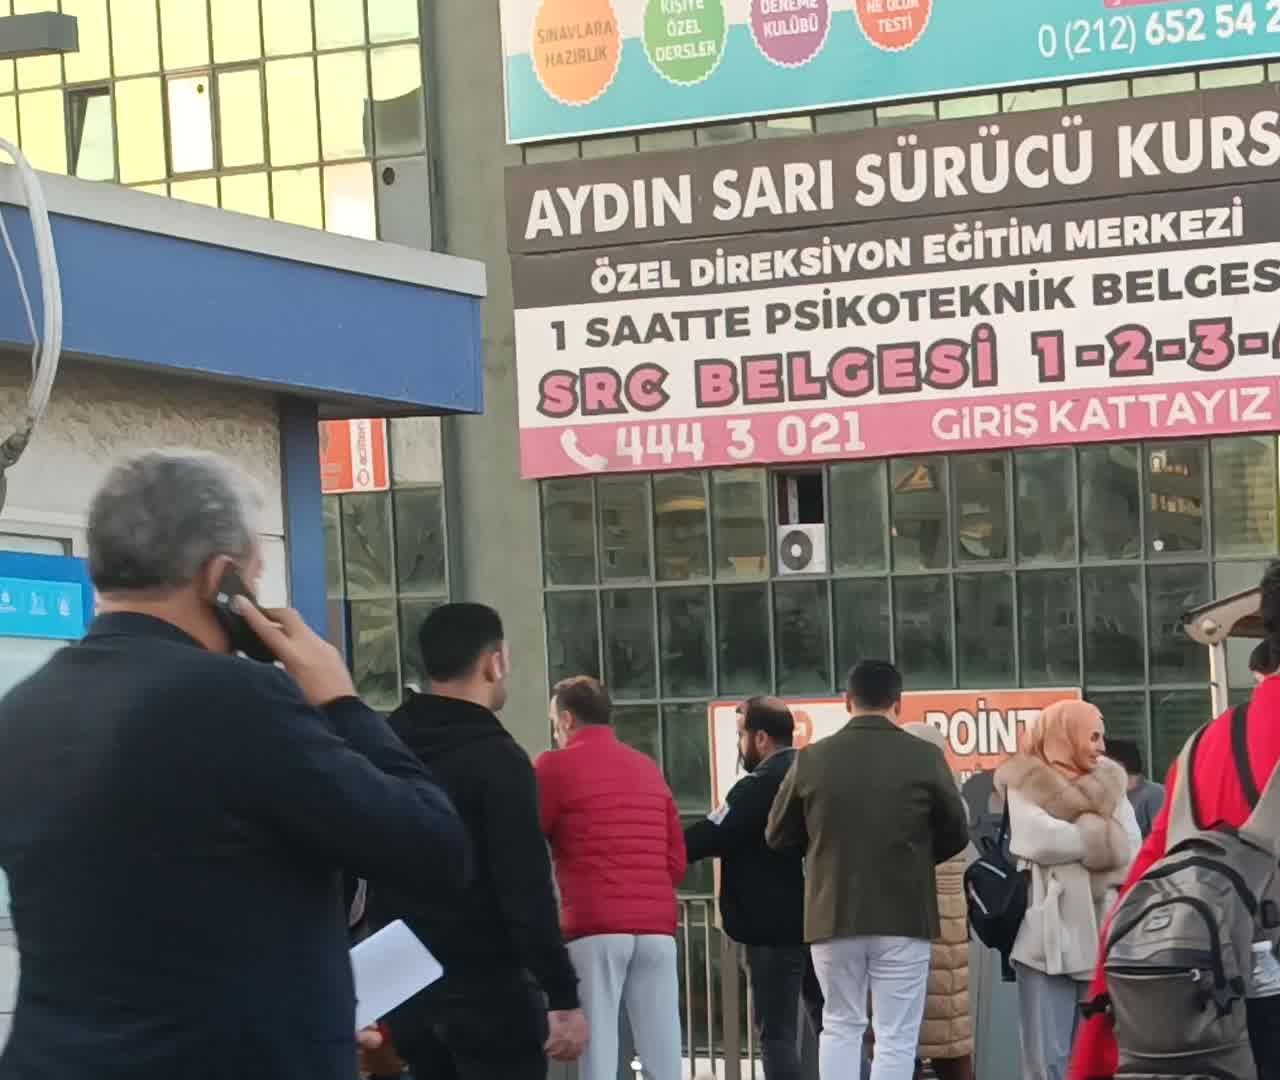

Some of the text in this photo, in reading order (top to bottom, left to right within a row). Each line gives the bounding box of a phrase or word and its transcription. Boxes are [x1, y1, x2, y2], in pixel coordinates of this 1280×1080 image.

[537, 21, 613, 45] SINAVLARA
[666, 17, 702, 38] ÖZEL
[763, 14, 819, 38] KULÜBÜ
[876, 15, 913, 33] TESTİ
[1038, 24, 1057, 58] 0
[1064, 14, 1137, 61] (212)
[1145, 7, 1206, 46] 652
[1215, 3, 1257, 39] 54
[545, 45, 609, 68] HAZIRLIK
[655, 36, 717, 62] DERSLER
[523, 174, 693, 241] AYDIN
[712, 159, 834, 222] SARI
[855, 114, 1093, 208] SÜRÜCÜ
[590, 195, 1244, 295] ÖZEL DİREKSİYON EĞİTİM MERKEZİ
[550, 320, 567, 351] 1
[585, 306, 750, 349] SAATTE
[766, 267, 1076, 335] PSİKOTEKNİK
[536, 362, 670, 418] SRC
[694, 322, 998, 409] BELGESİ
[616, 386, 1273, 467] 444 3 021 GİRİŞ KATTAYIZ
